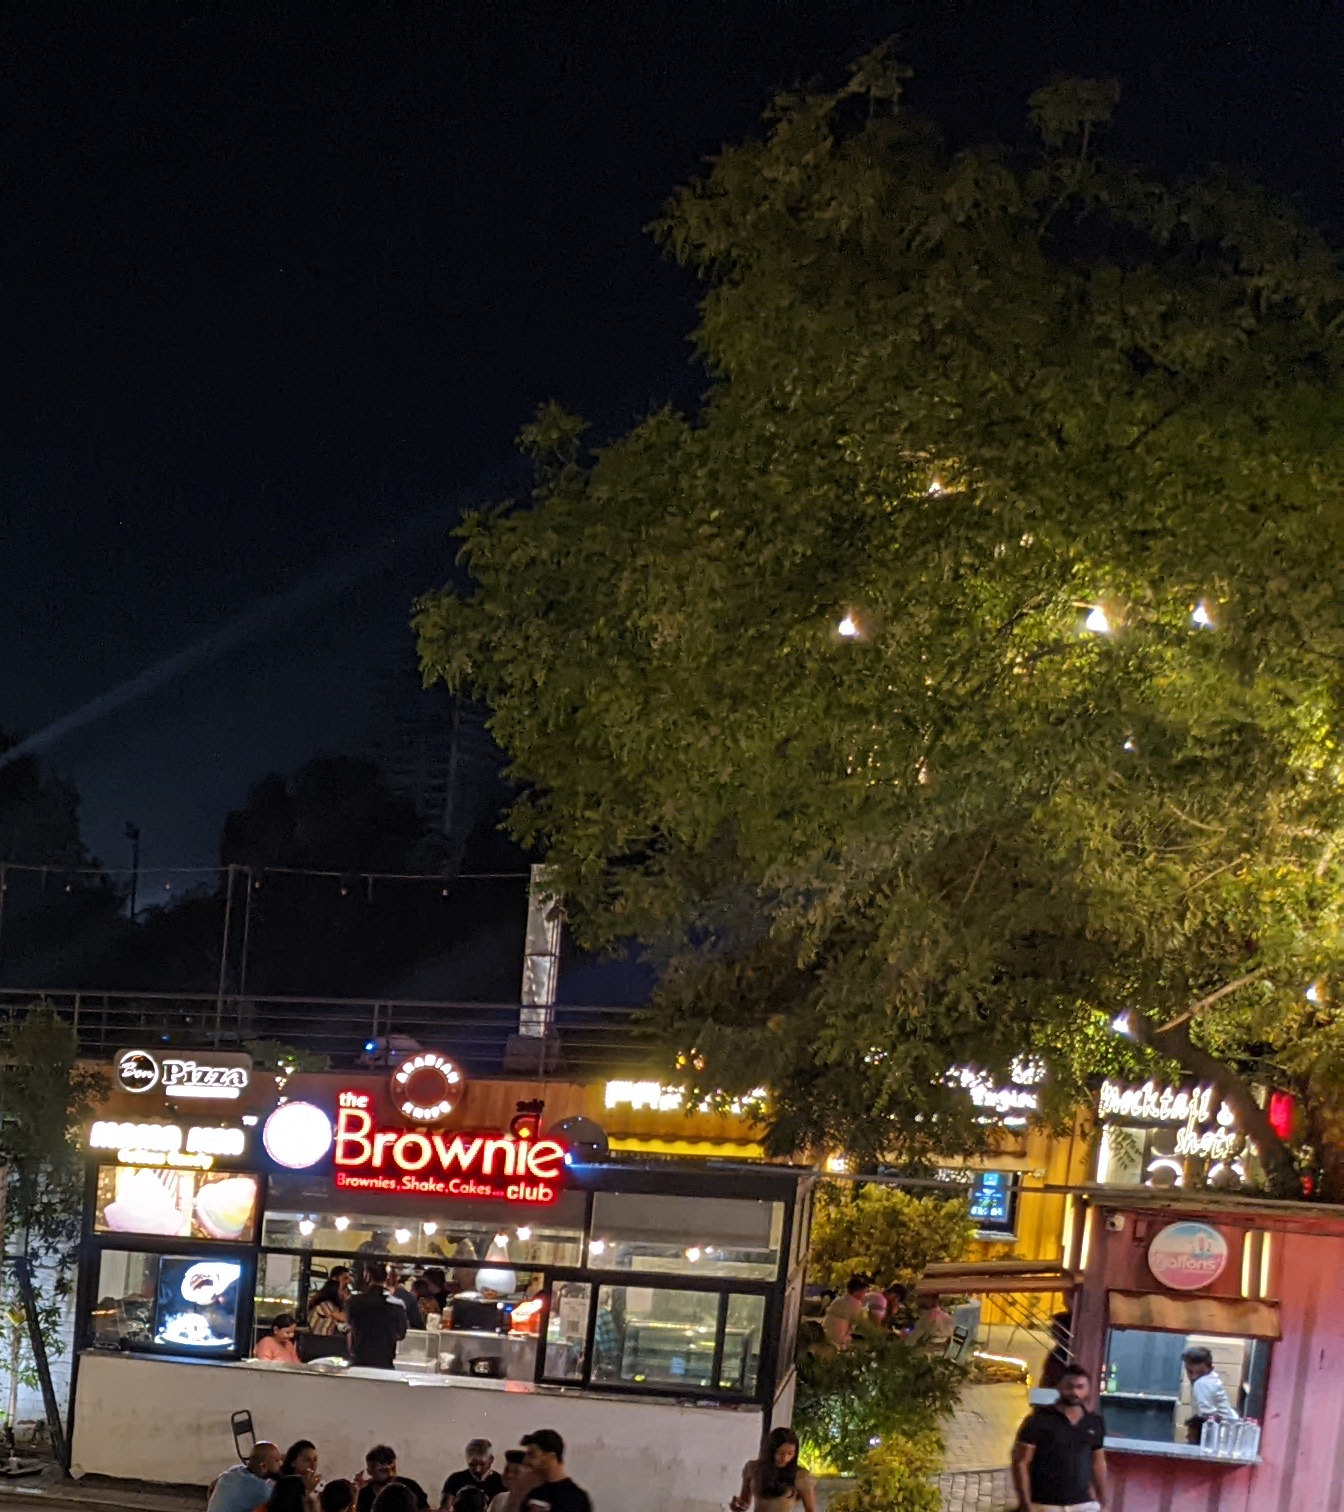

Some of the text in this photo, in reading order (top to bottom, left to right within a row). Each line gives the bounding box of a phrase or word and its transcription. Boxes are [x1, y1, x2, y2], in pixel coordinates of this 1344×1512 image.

[162, 1060, 247, 1087] Pizza
[339, 1092, 369, 1108] the
[335, 1108, 564, 1178] Brownie
[507, 1182, 553, 1201] club
